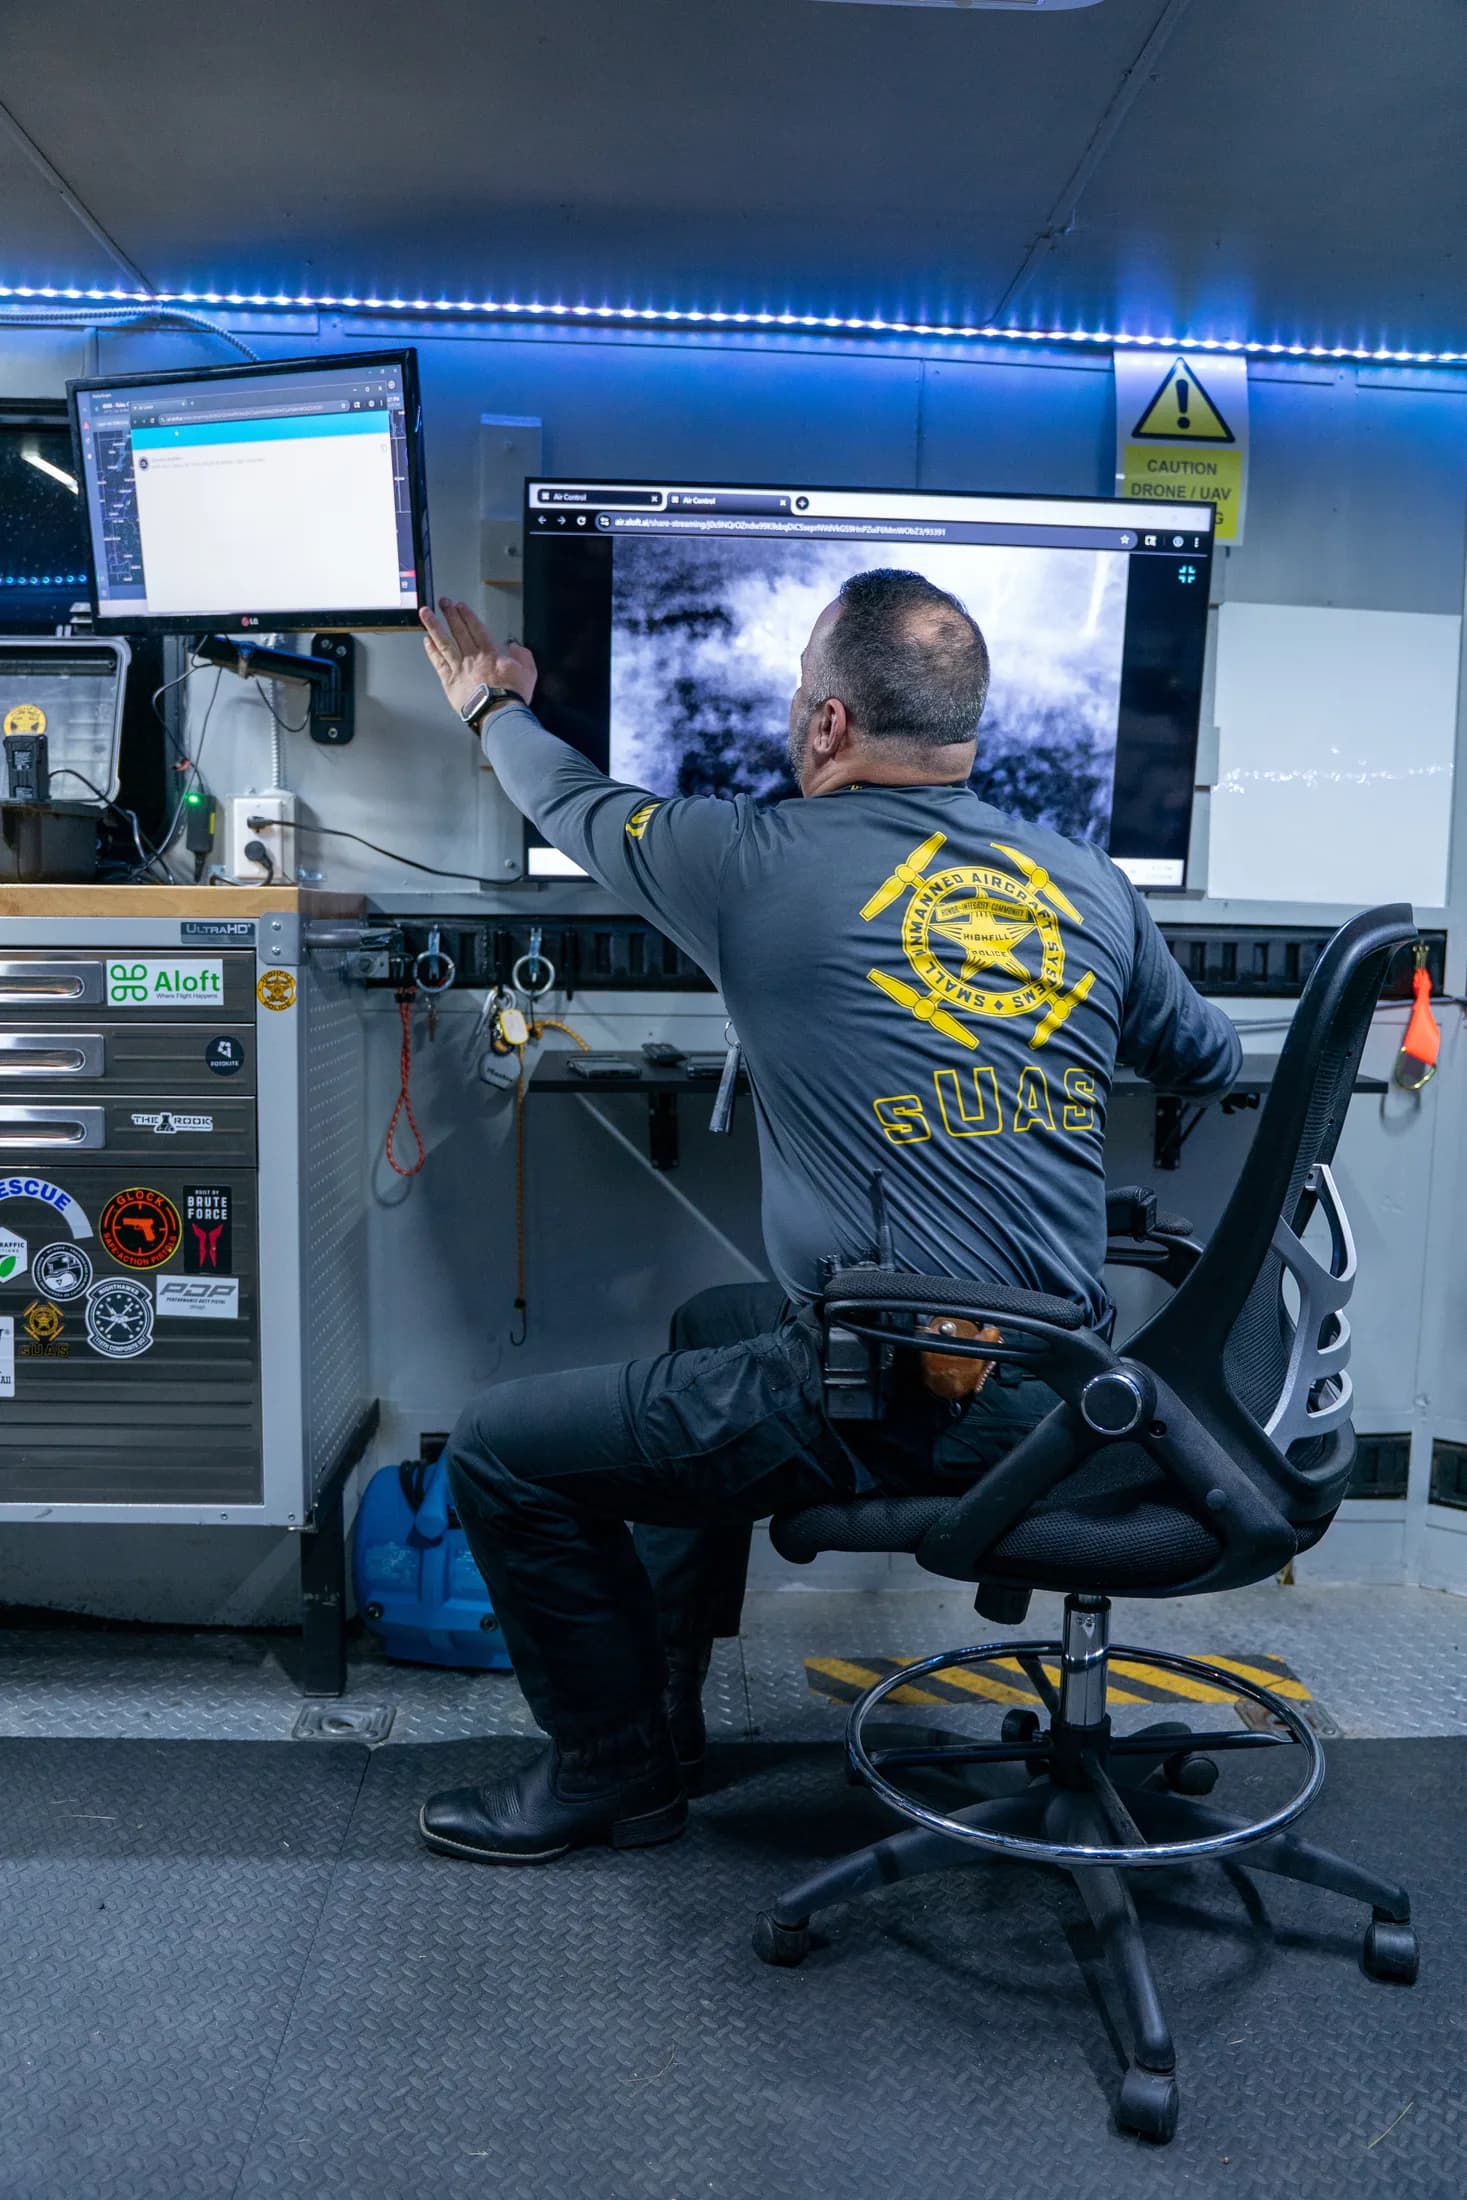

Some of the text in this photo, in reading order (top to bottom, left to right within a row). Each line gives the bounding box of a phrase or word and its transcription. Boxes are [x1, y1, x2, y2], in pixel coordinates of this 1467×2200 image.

[1147, 459, 1217, 475] CAUTION
[553, 493, 587, 502] Air Control
[1131, 482, 1186, 498] DRONE
[1200, 486, 1231, 500] UAV
[683, 496, 716, 505] Air Control
[971, 872, 1054, 930] AIRCRAFT
[910, 872, 964, 956] UNMANNED
[991, 902, 1025, 917] COMMUNITY
[963, 933, 1010, 942] HIGHFILL
[971, 950, 1010, 958] POLICE
[154, 970, 220, 992] Aloft
[1013, 941, 1060, 1008] SYSTEMS
[925, 960, 986, 1008] SMALL
[133, 1115, 212, 1126] THE ROOK
[0, 1179, 71, 1212] ESCUE
[116, 1190, 164, 1206] GLOCK
[187, 1196, 228, 1208] BRUTE
[187, 1208, 228, 1220] FORCE
[151, 1235, 177, 1263] PISTOLS
[160, 1282, 237, 1297] PDP
